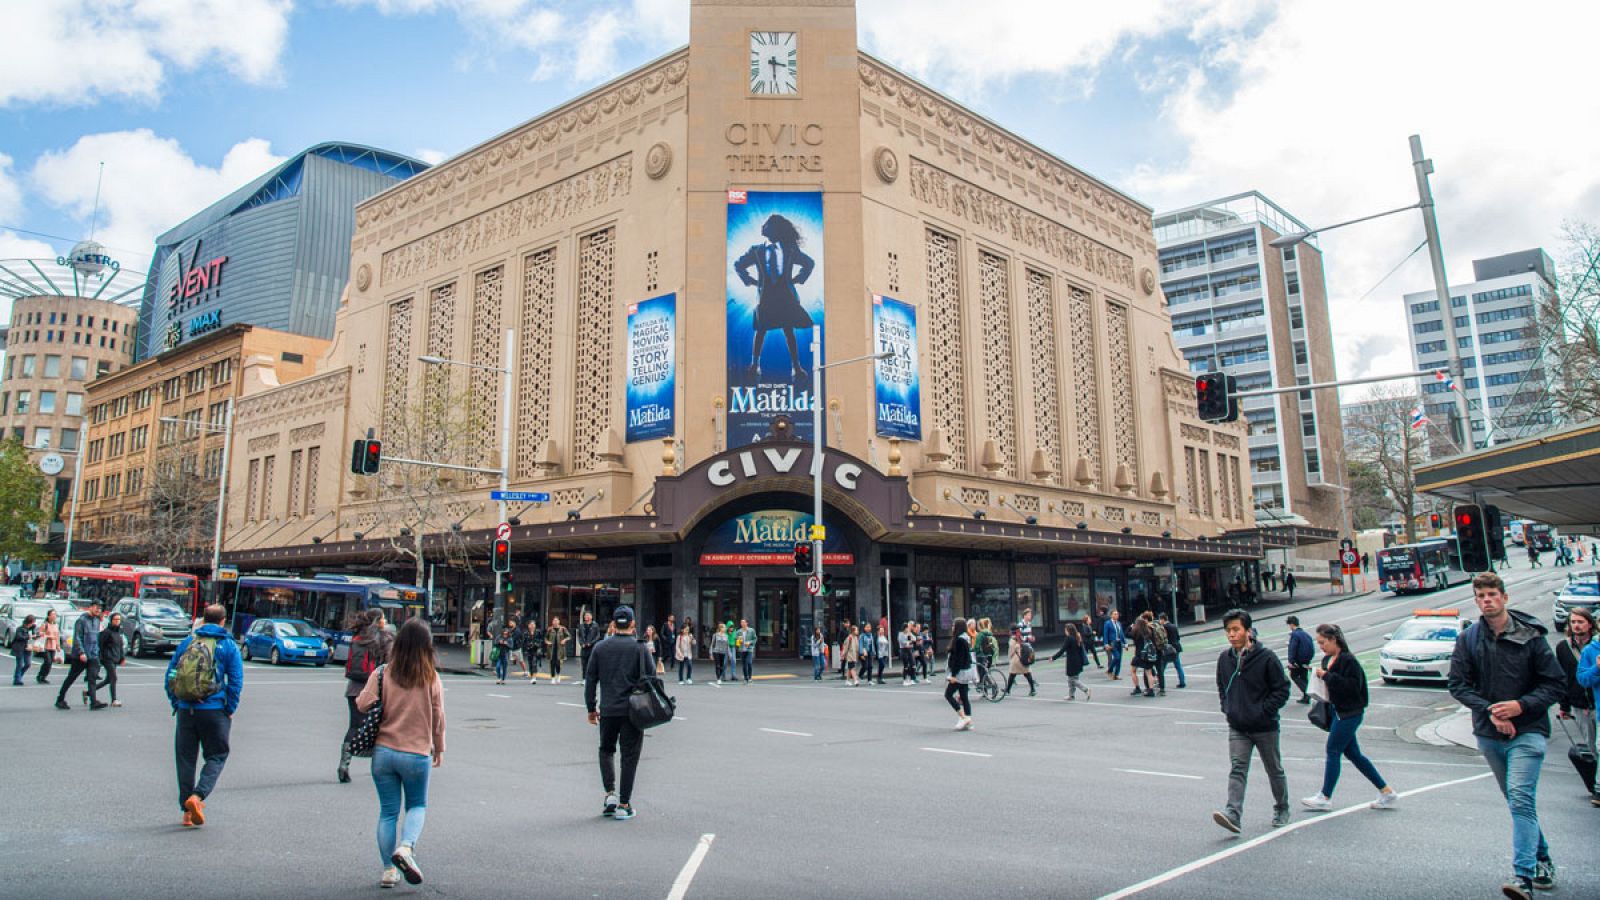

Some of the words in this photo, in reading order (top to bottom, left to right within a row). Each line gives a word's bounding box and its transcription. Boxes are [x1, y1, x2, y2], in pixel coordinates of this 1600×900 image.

[725, 123, 823, 146] CIVIC
[726, 155, 823, 172] THEATRE
[165, 239, 229, 309] EVENT
[189, 307, 222, 333] IMAX
[632, 323, 669, 338] MAGICAL
[632, 332, 669, 348] MOVING
[880, 323, 911, 340] SHOWS
[633, 349, 668, 366] STORY
[633, 361, 668, 376] TELLING
[629, 403, 671, 428] Matilda
[879, 403, 918, 425] Matilda
[707, 448, 862, 490] CIVIC
